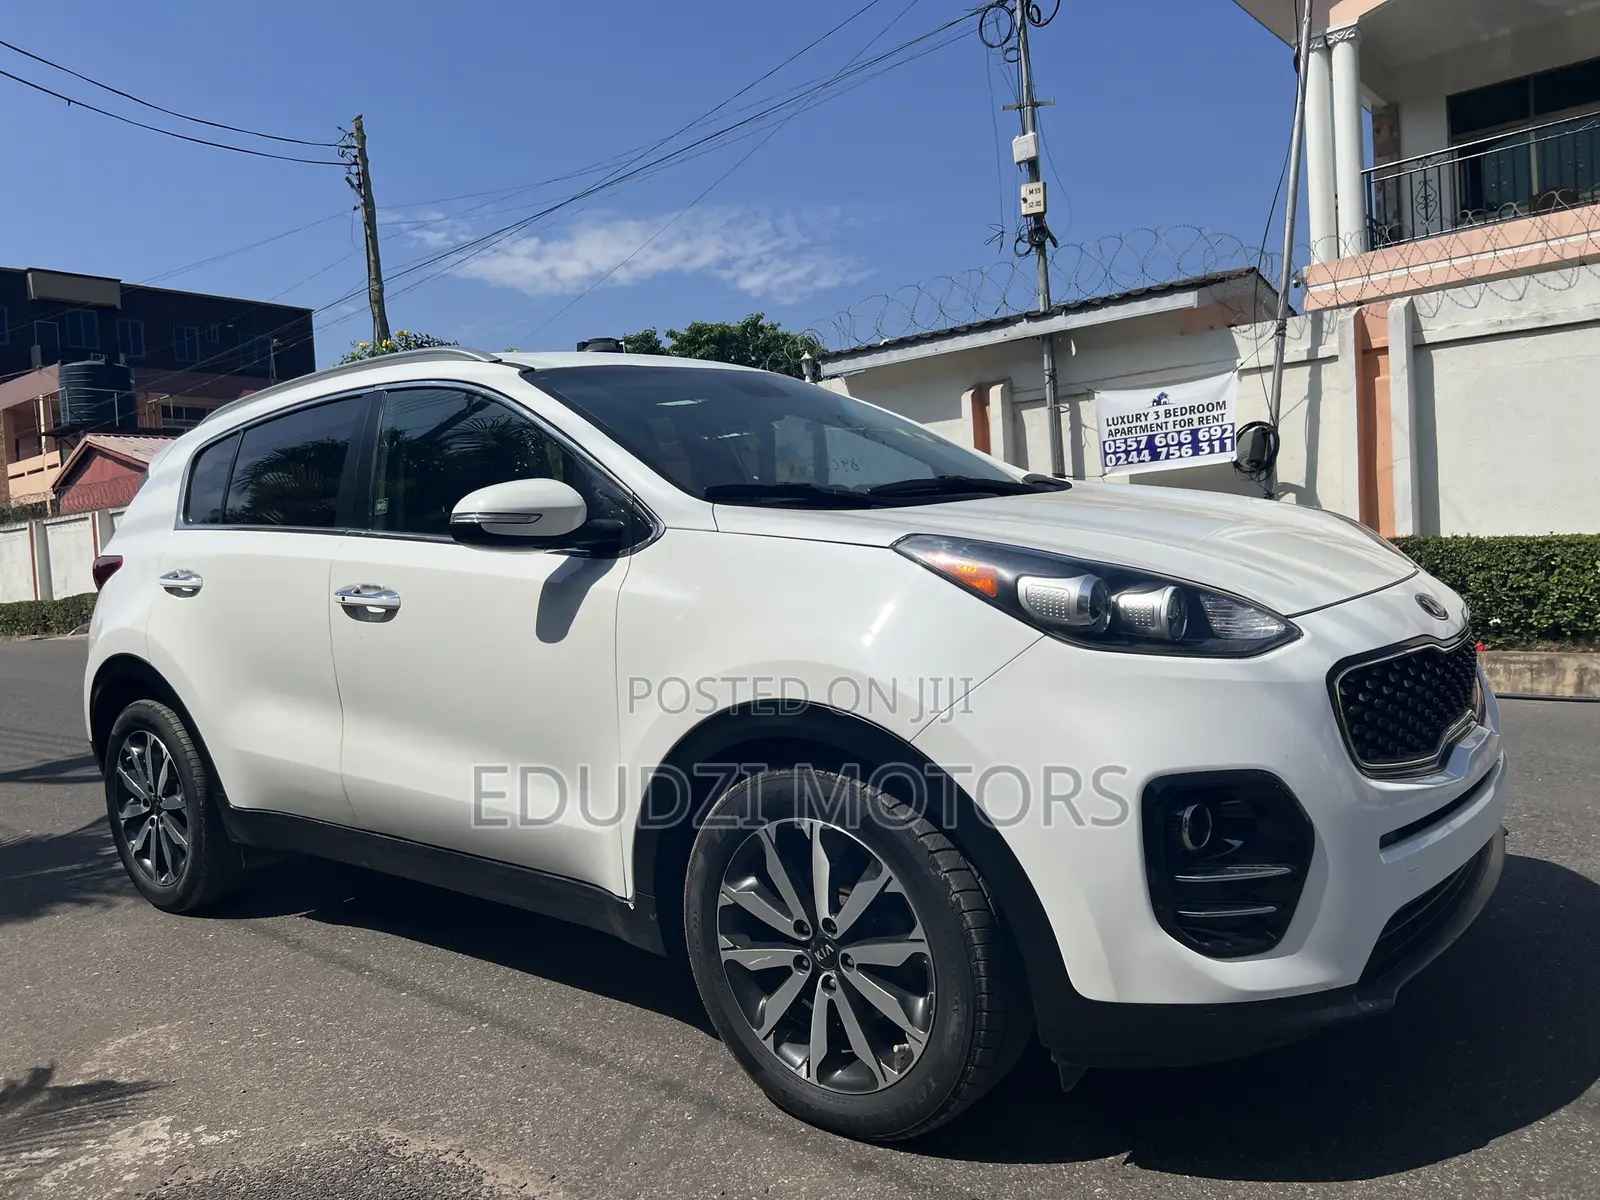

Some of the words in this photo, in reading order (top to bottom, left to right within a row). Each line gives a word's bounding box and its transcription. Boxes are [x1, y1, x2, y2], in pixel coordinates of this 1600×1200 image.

[1106, 411, 1149, 427] LUXURY
[1153, 409, 1160, 420] 3
[1164, 400, 1226, 419] BEDROOM
[1107, 421, 1169, 438] APARTMENT
[1172, 416, 1194, 430] FOR
[1198, 413, 1225, 426] RENT
[1104, 436, 1147, 453] 0557
[1154, 430, 1192, 447] 606
[1198, 424, 1233, 441] 692
[1105, 449, 1150, 467] 0244
[1156, 444, 1192, 460] 756
[1199, 438, 1232, 454] 311
[814, 944, 835, 962] KIA
